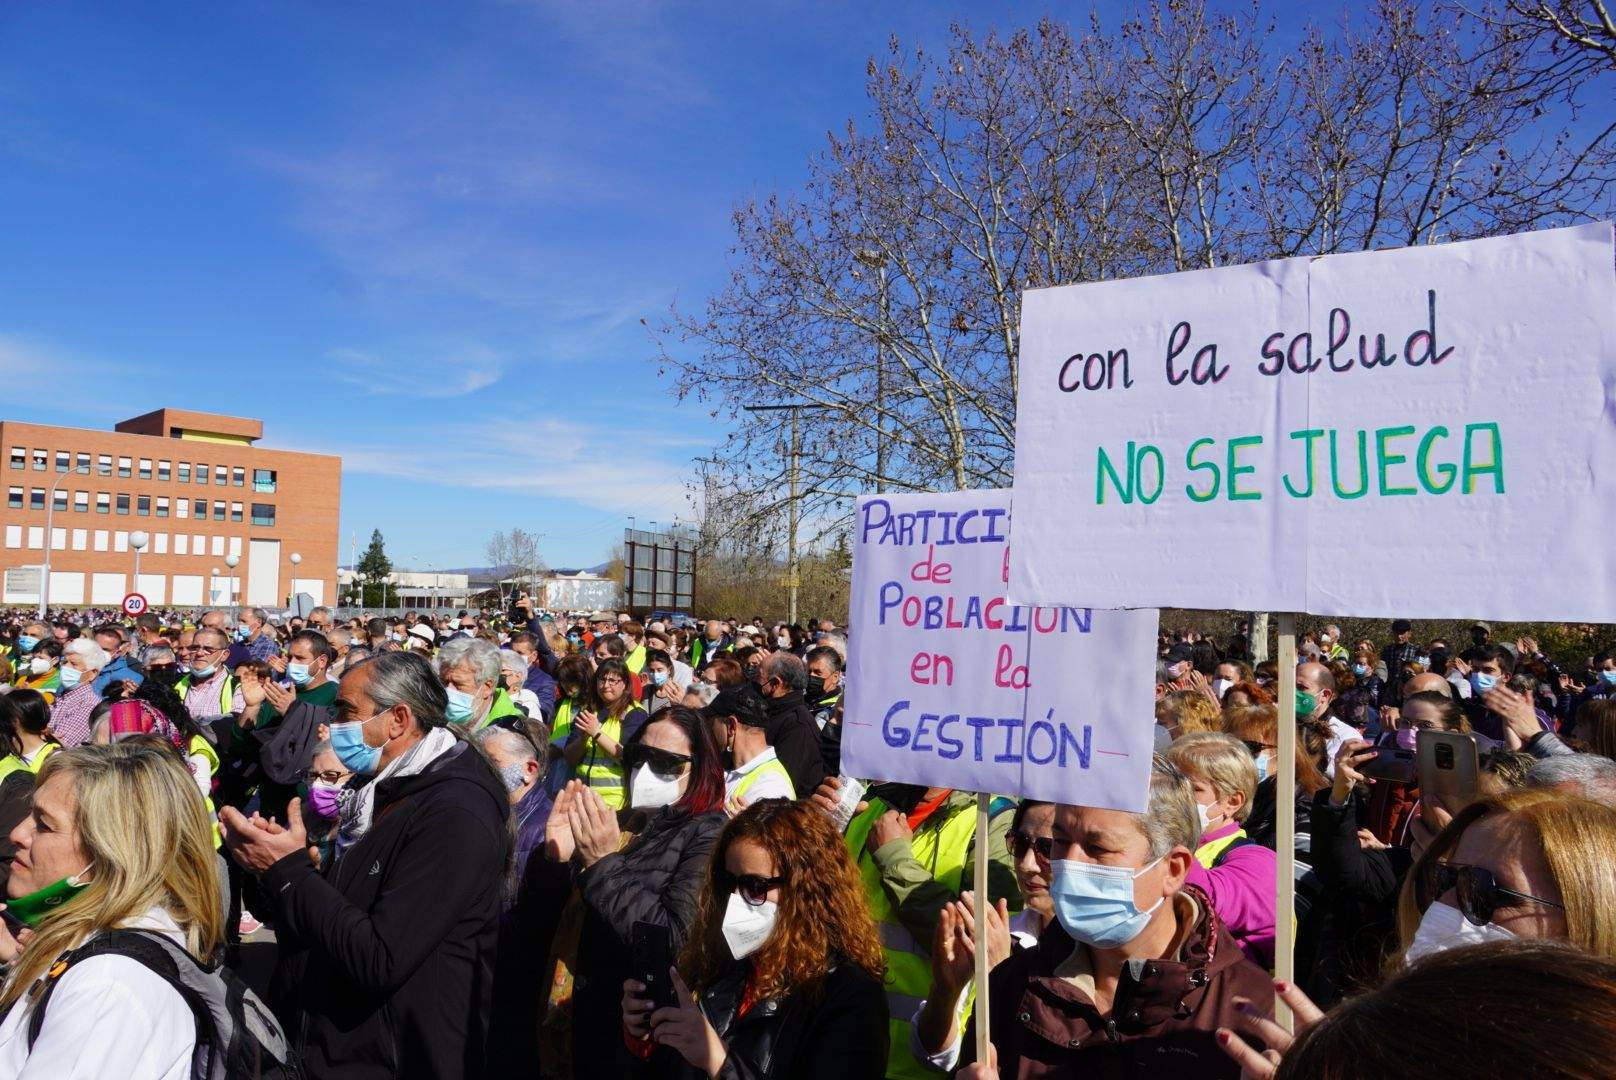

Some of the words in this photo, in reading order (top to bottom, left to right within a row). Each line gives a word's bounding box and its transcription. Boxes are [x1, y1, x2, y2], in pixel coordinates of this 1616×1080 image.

[1057, 347, 1134, 393] con
[1165, 321, 1230, 386] la
[1258, 289, 1455, 377] salud
[1096, 440, 1165, 505] NO
[1185, 434, 1264, 503] SE
[1283, 421, 1505, 500] JUEGA
[861, 499, 1011, 546] PARTICI
[910, 544, 953, 584] de
[128, 599, 141, 609] 20
[910, 651, 953, 686] en
[994, 643, 1031, 690] la
[882, 700, 1092, 769] GESTIÓN
